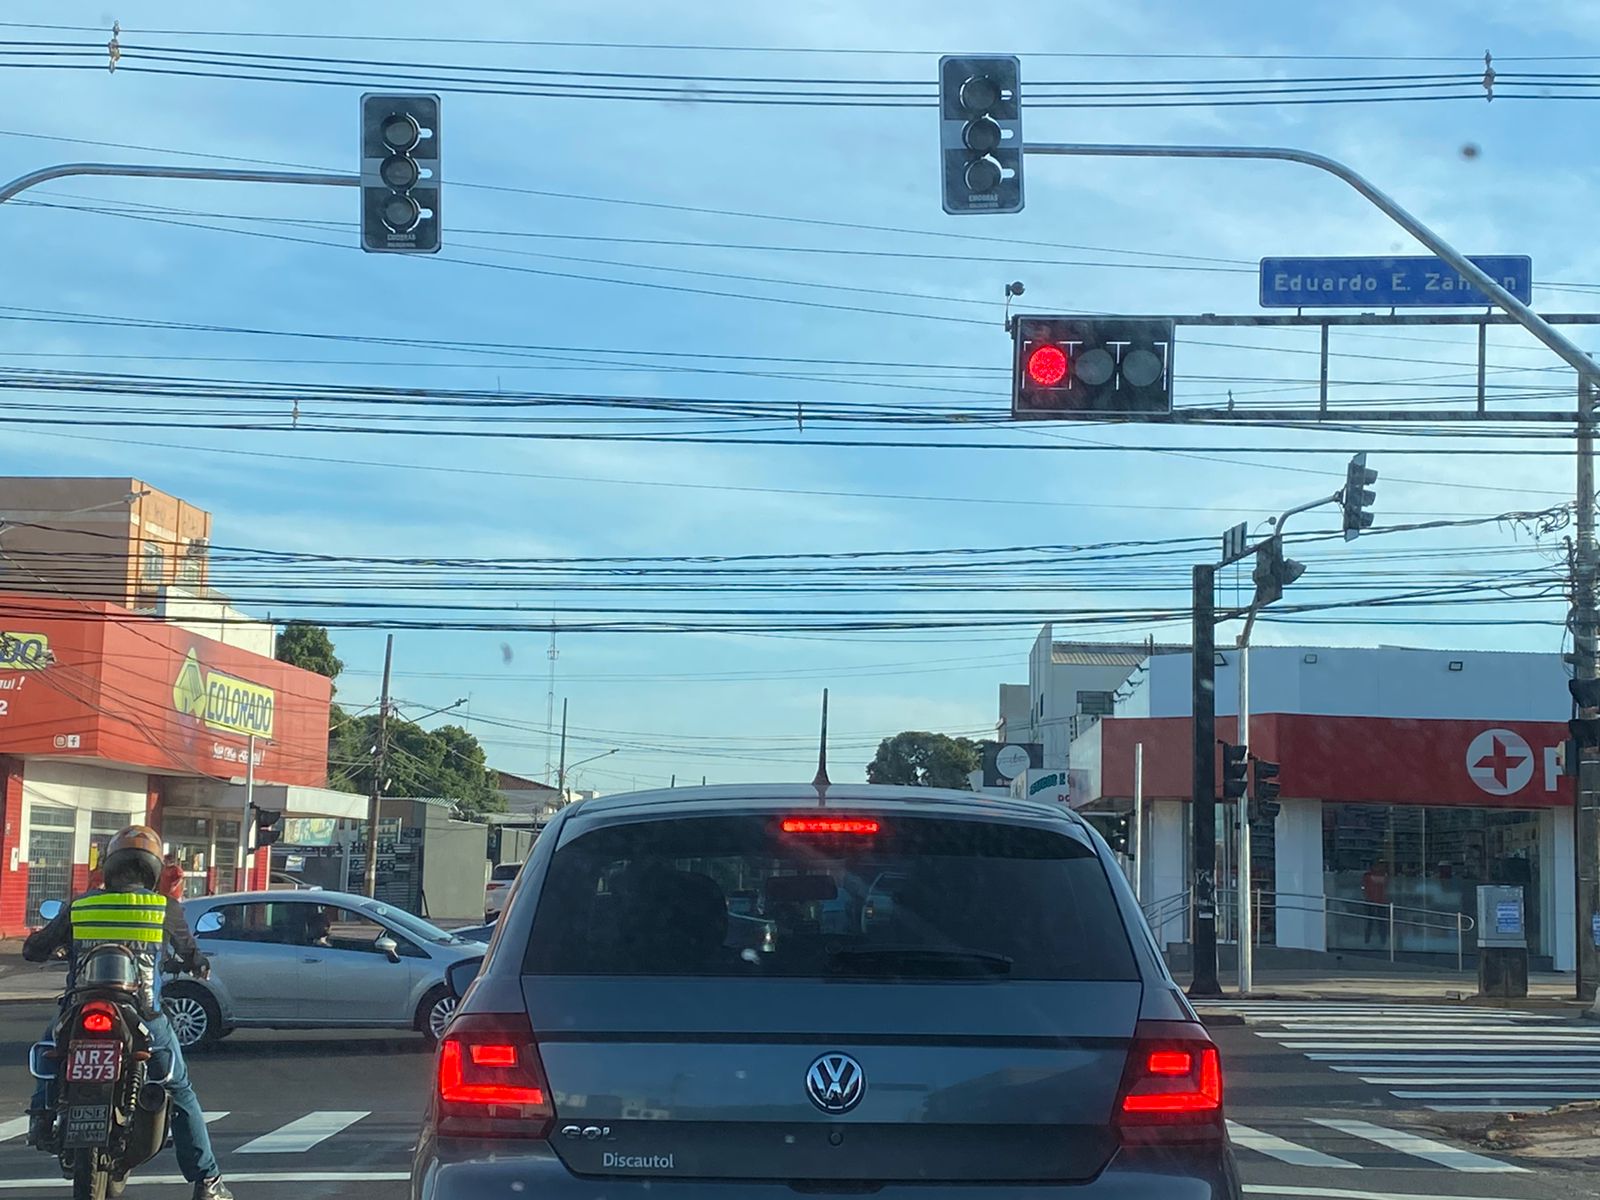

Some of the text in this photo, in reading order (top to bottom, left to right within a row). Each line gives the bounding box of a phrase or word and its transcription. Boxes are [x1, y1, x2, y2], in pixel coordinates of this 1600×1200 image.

[1274, 273, 1516, 291] Eduardo E. Zahn
[207, 681, 272, 732] COLORADO
[75, 1051, 115, 1065] NRZ
[72, 1065, 115, 1080] 5373
[70, 1122, 106, 1131] MOTO
[603, 1152, 675, 1169] Discautol
